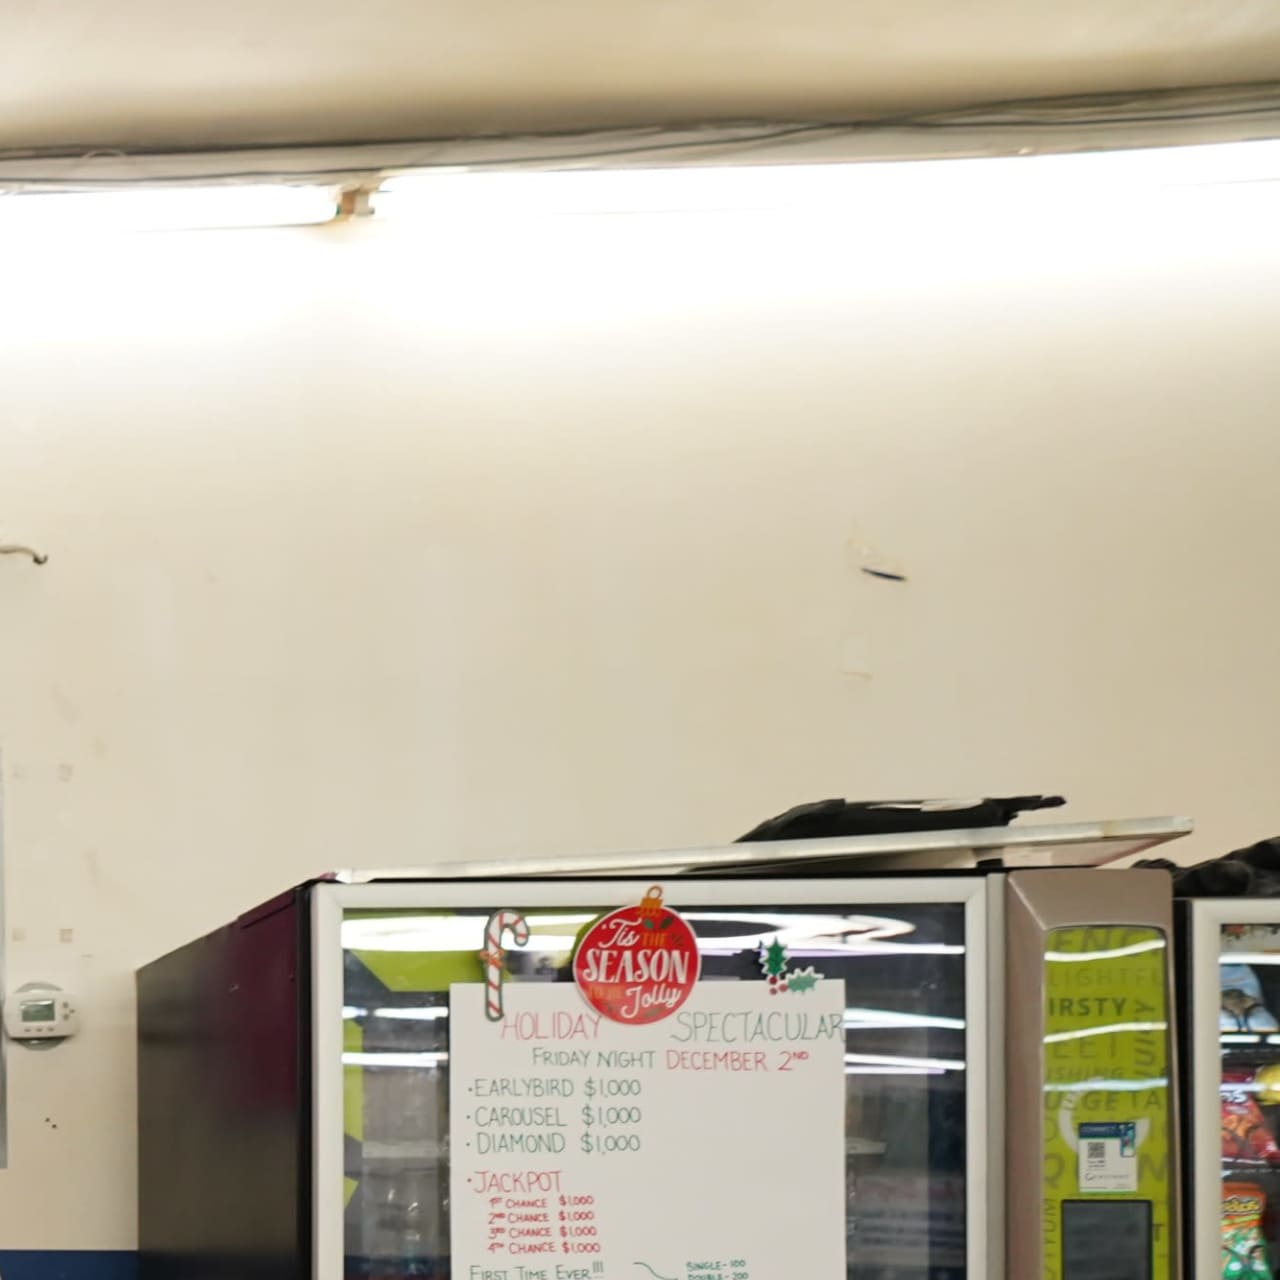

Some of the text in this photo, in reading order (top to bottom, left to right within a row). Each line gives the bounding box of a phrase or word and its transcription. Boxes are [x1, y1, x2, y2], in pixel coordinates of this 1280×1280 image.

[582, 948, 689, 984] SEASON
[621, 983, 681, 1018] Jolly
[501, 1011, 844, 1043] HOLIDAY SPECTACULAR
[532, 1047, 809, 1072] FRIDAY NIGHT DECEMBER 2ND
[474, 1077, 641, 1100] EARLYBIRD $1,000
[474, 1105, 641, 1129] CAROUSEL $1,000
[477, 1132, 640, 1156] DIAMOND $1,000
[474, 1170, 562, 1193] JACKPOT
